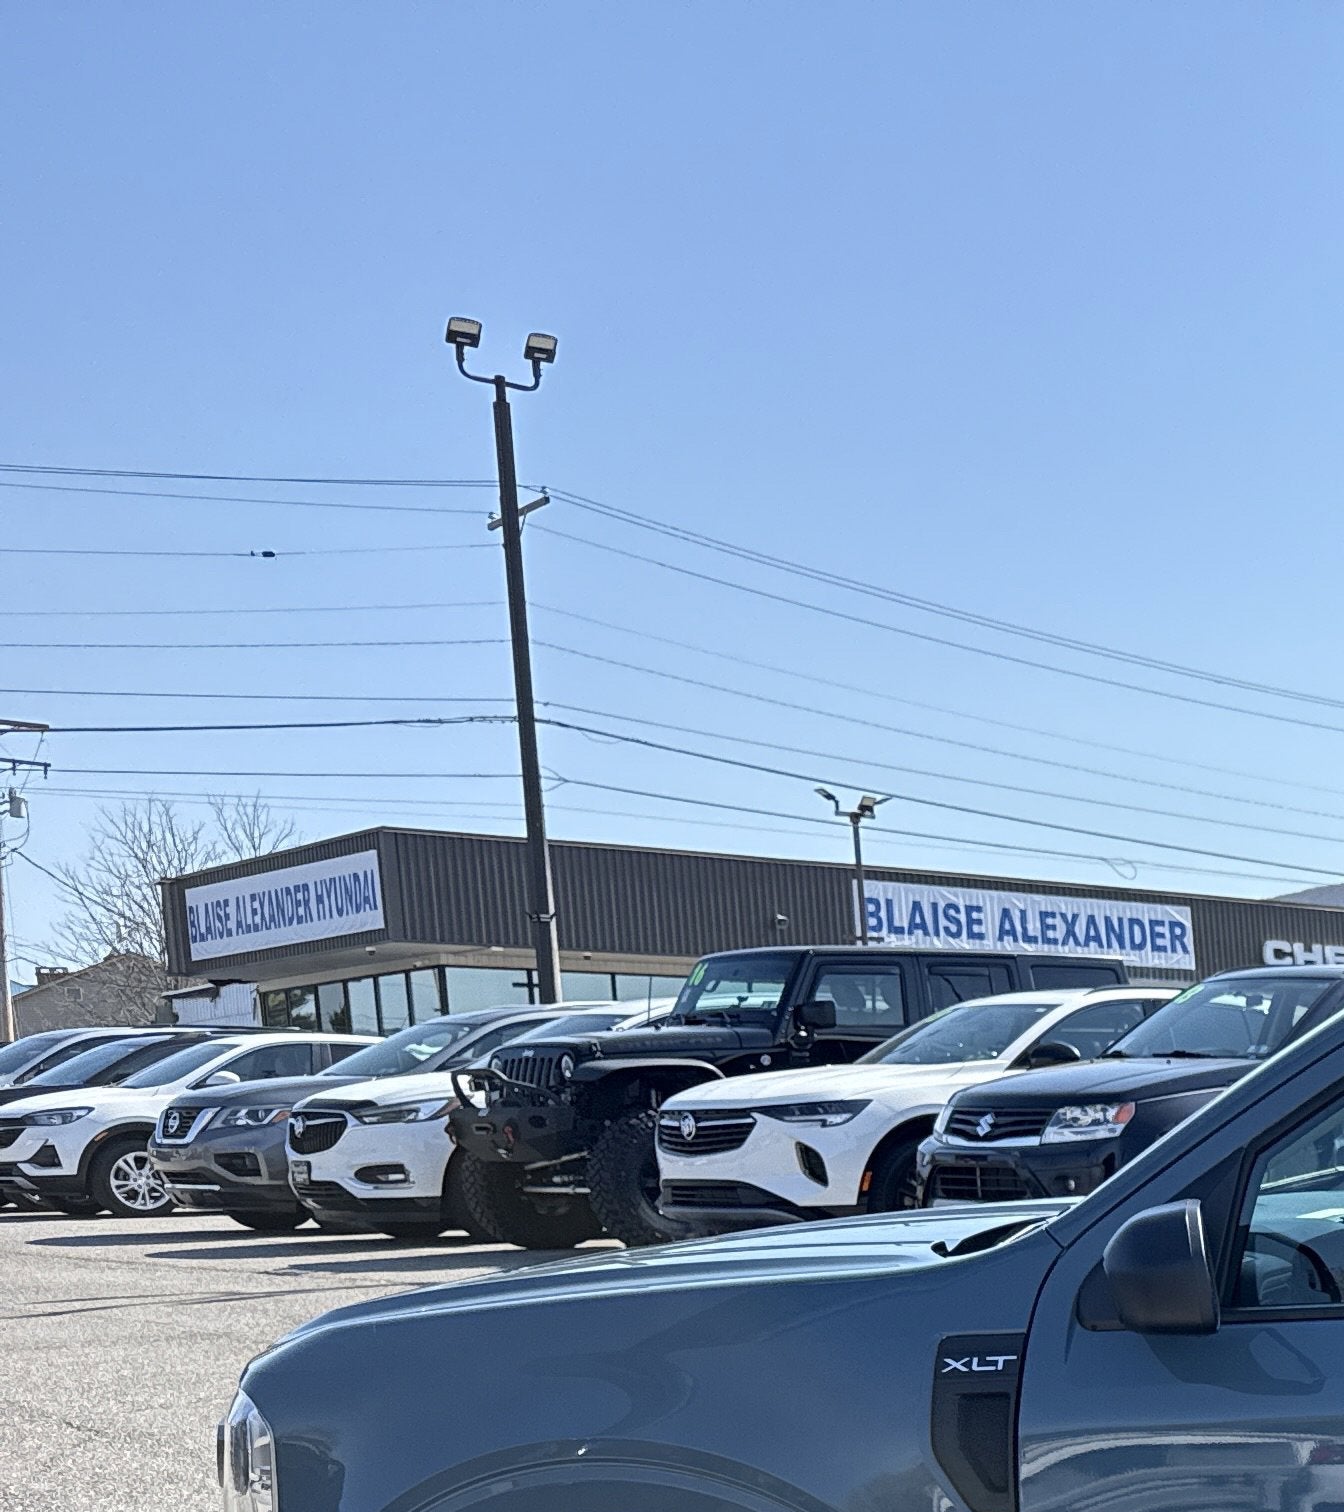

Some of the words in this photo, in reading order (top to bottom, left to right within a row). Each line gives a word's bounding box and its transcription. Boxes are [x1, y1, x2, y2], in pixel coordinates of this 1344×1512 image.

[188, 898, 233, 944] BLAISE
[235, 883, 314, 936] ALEXANDER
[314, 869, 379, 921] HYUNDAI
[865, 897, 986, 940] BLAISE
[997, 908, 1192, 954] ALEXANDER
[941, 1355, 1018, 1373] XLT
